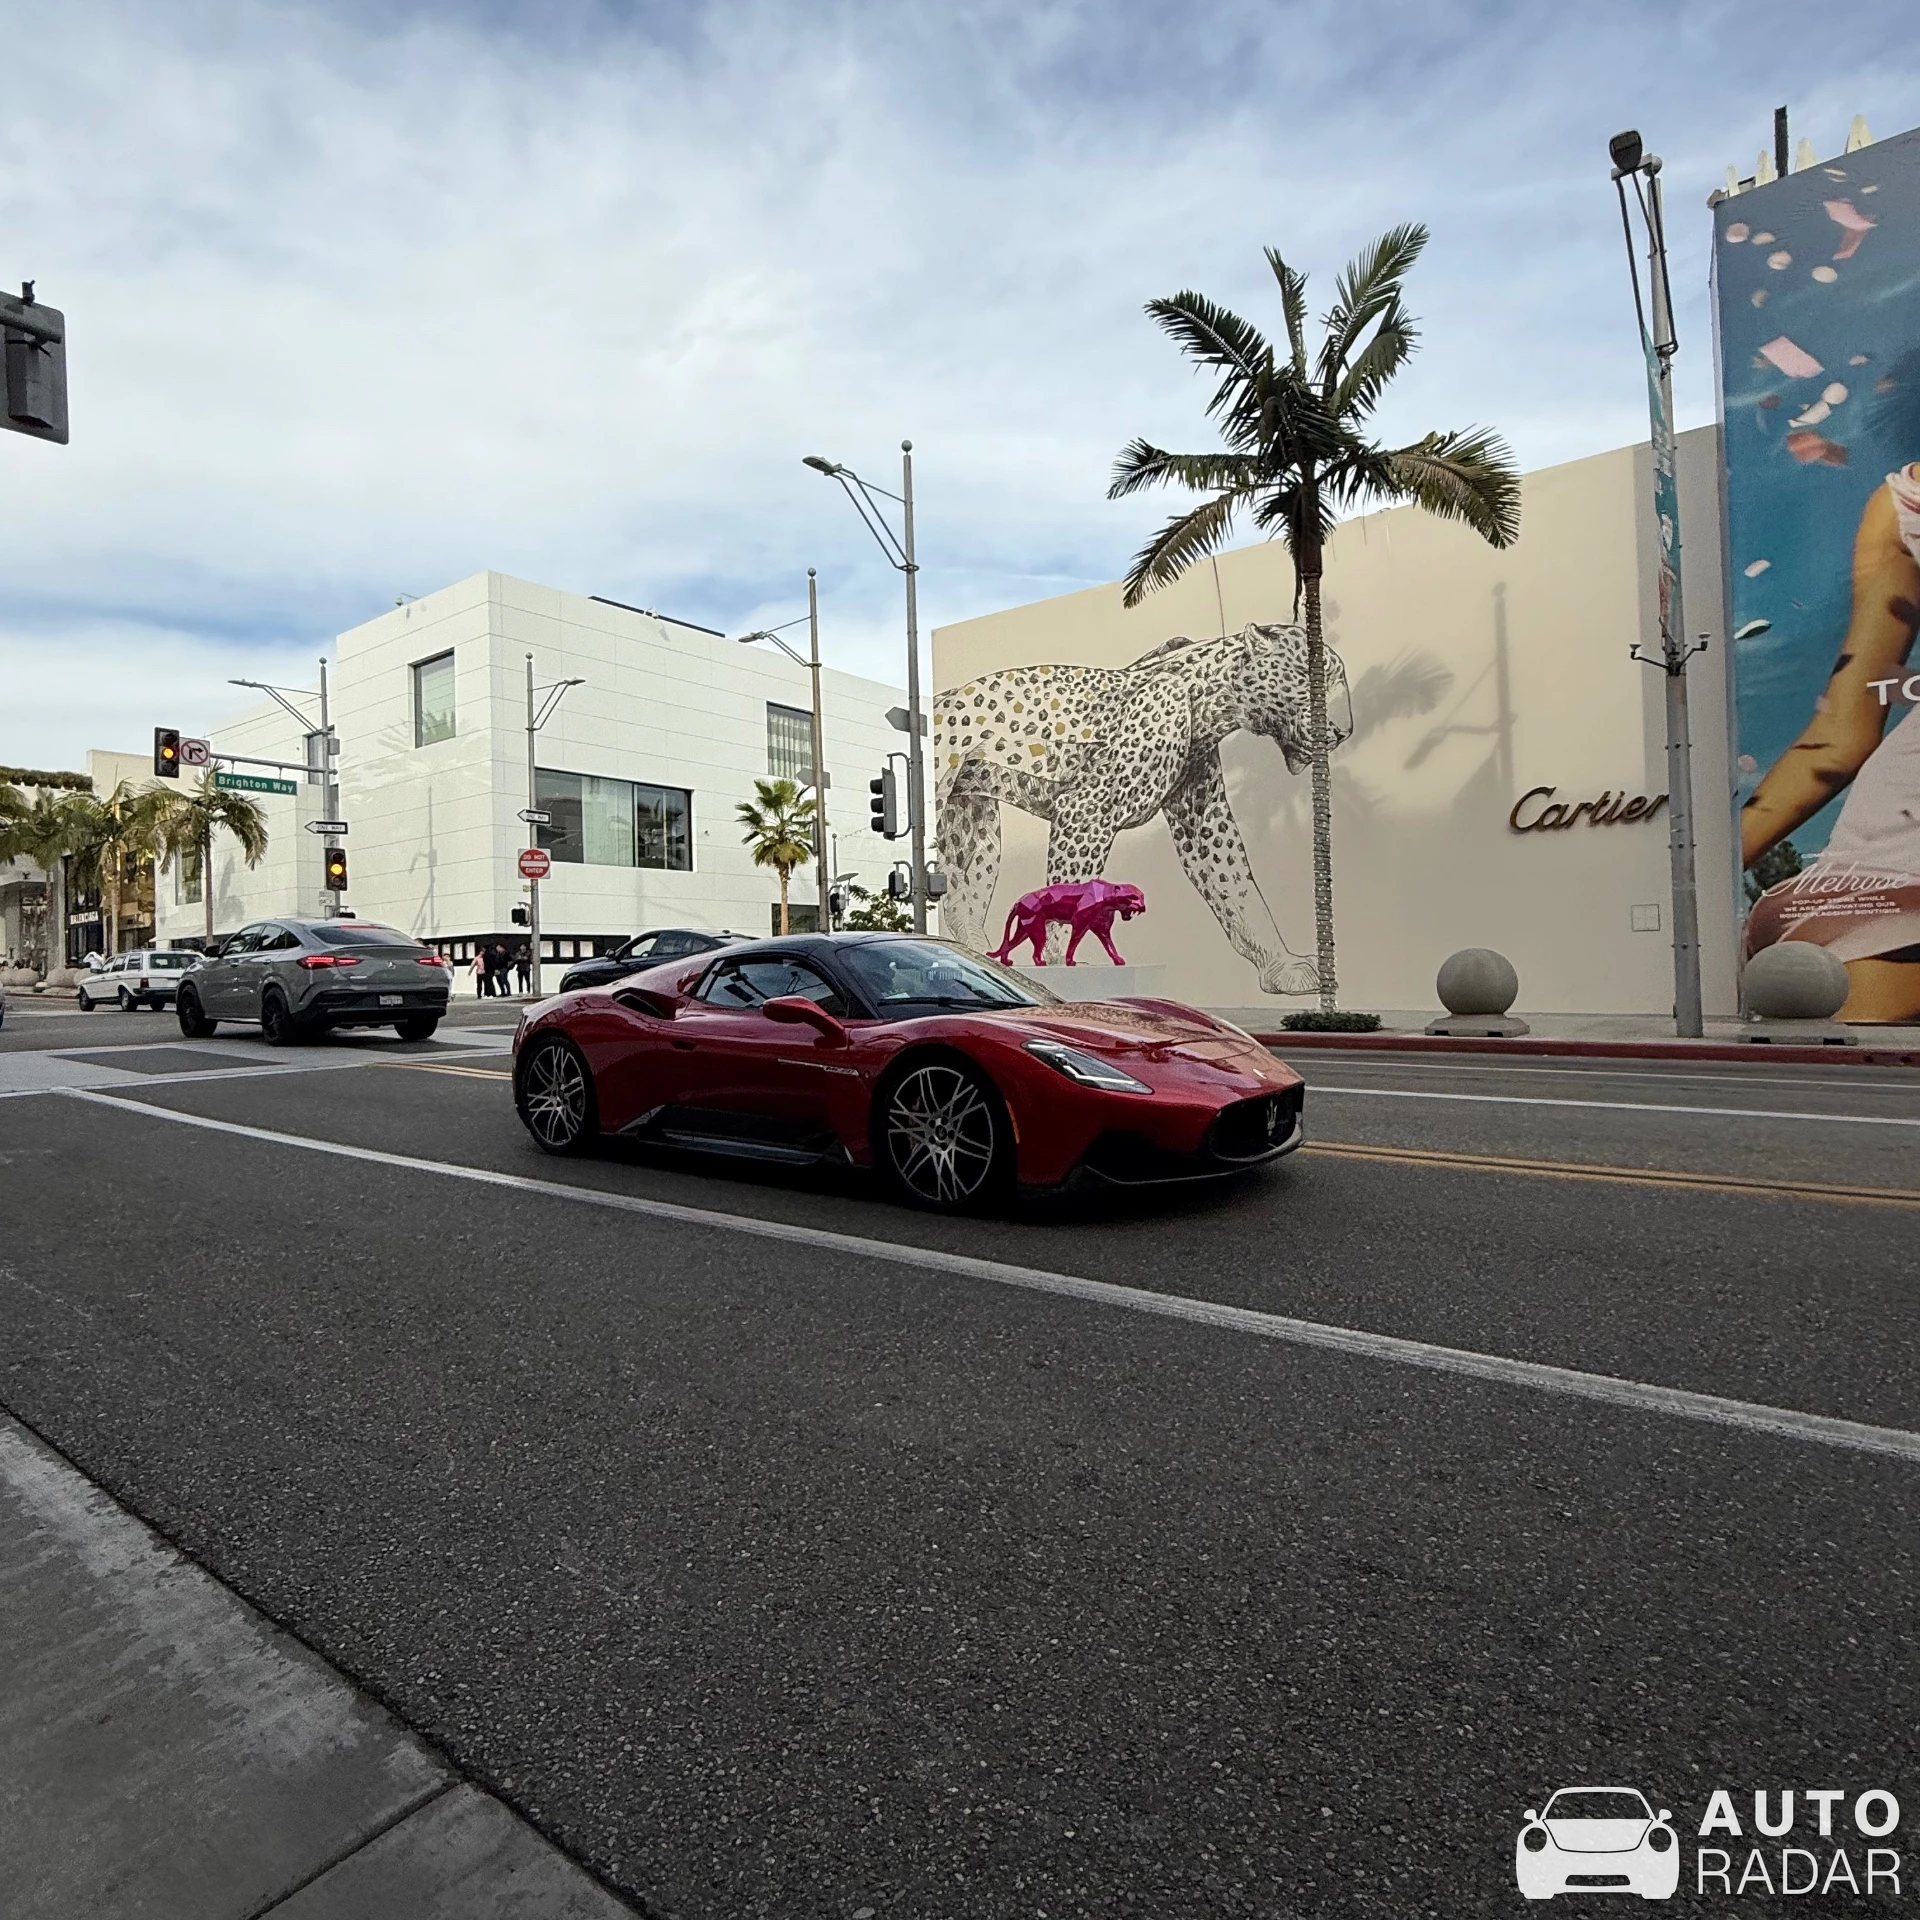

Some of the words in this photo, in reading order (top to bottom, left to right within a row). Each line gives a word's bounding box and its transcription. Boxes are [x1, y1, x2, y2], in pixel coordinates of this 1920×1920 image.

[218, 776, 267, 789] Brighton
[272, 781, 293, 793] Way
[1509, 786, 1670, 831] Cartier
[1761, 860, 1910, 897] Melrose
[1818, 902, 1874, 911] RENOVATING
[1827, 896, 1856, 904] STORE
[70, 910, 99, 925] BALENCIAGA
[1809, 909, 1853, 917] FLAGSHIP
[1854, 907, 1901, 916] BOUTIQUE
